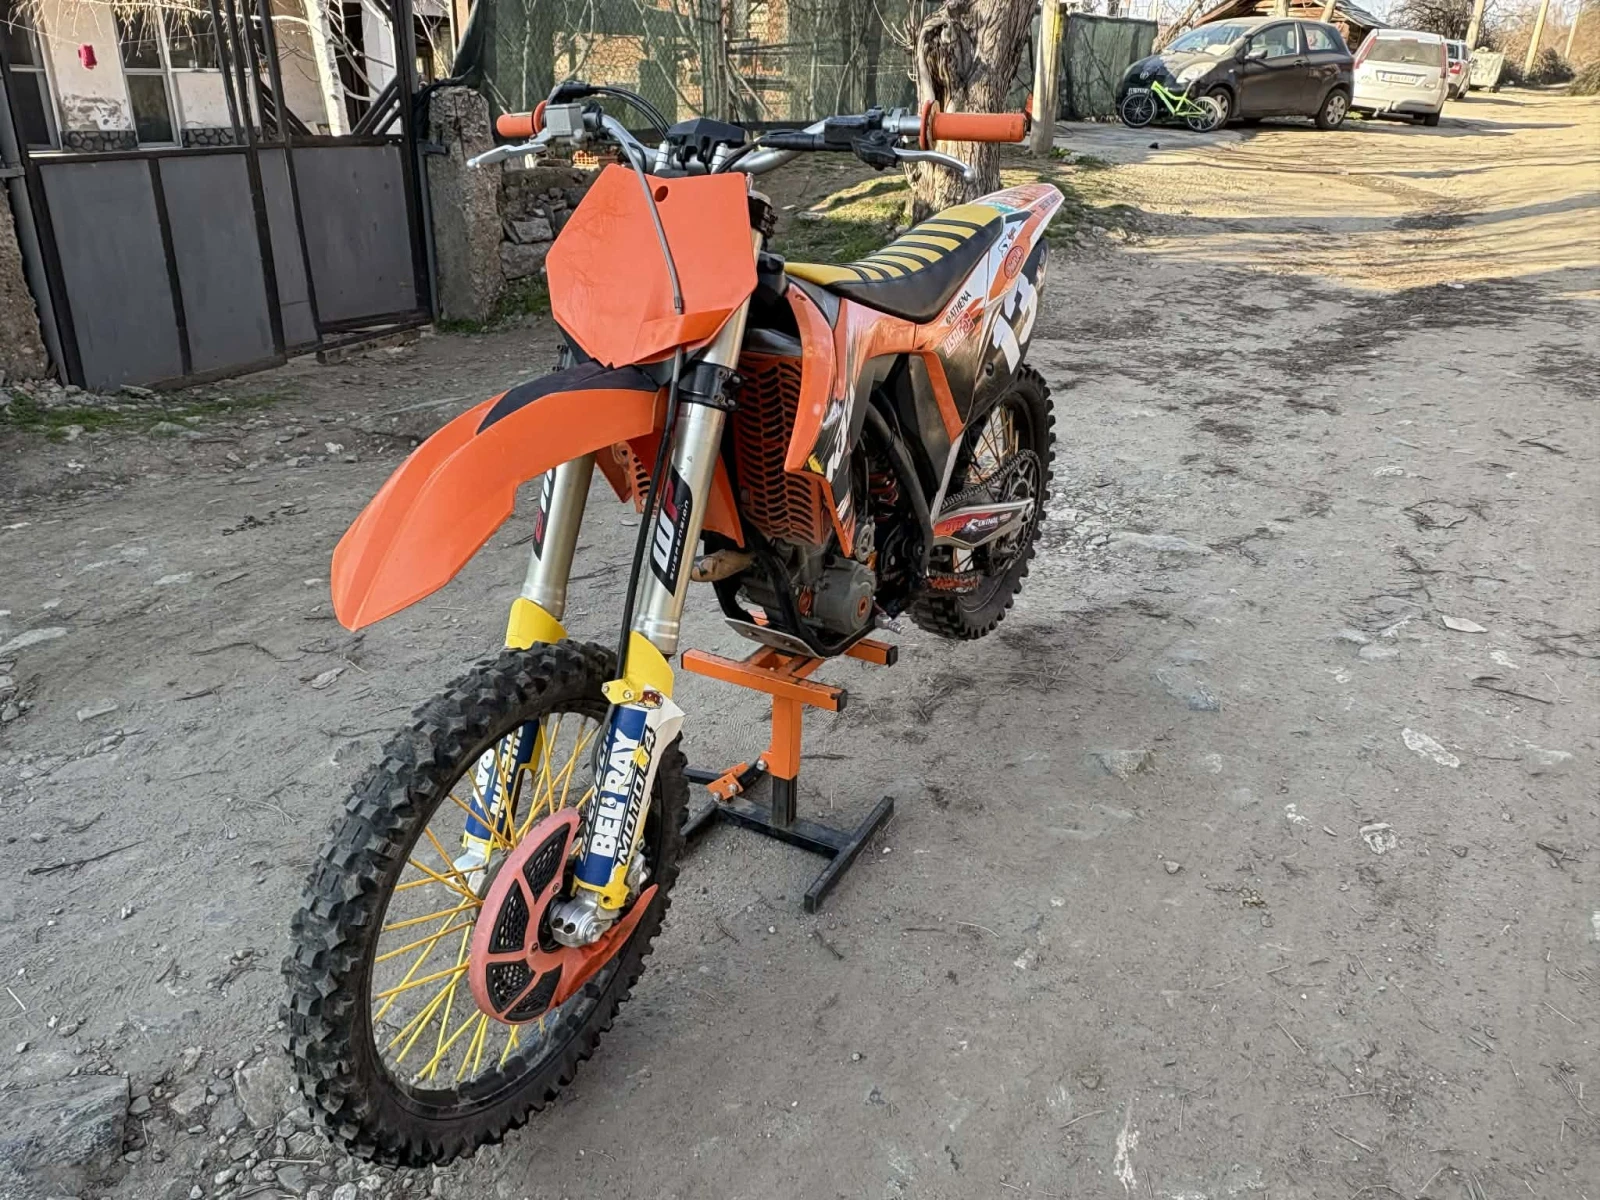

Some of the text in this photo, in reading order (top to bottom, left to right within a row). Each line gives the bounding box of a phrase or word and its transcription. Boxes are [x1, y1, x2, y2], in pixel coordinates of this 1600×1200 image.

[950, 290, 972, 317] ATHENA
[653, 480, 678, 574] WP
[591, 728, 640, 858] BEL RAY
[616, 774, 646, 866] MOTO
